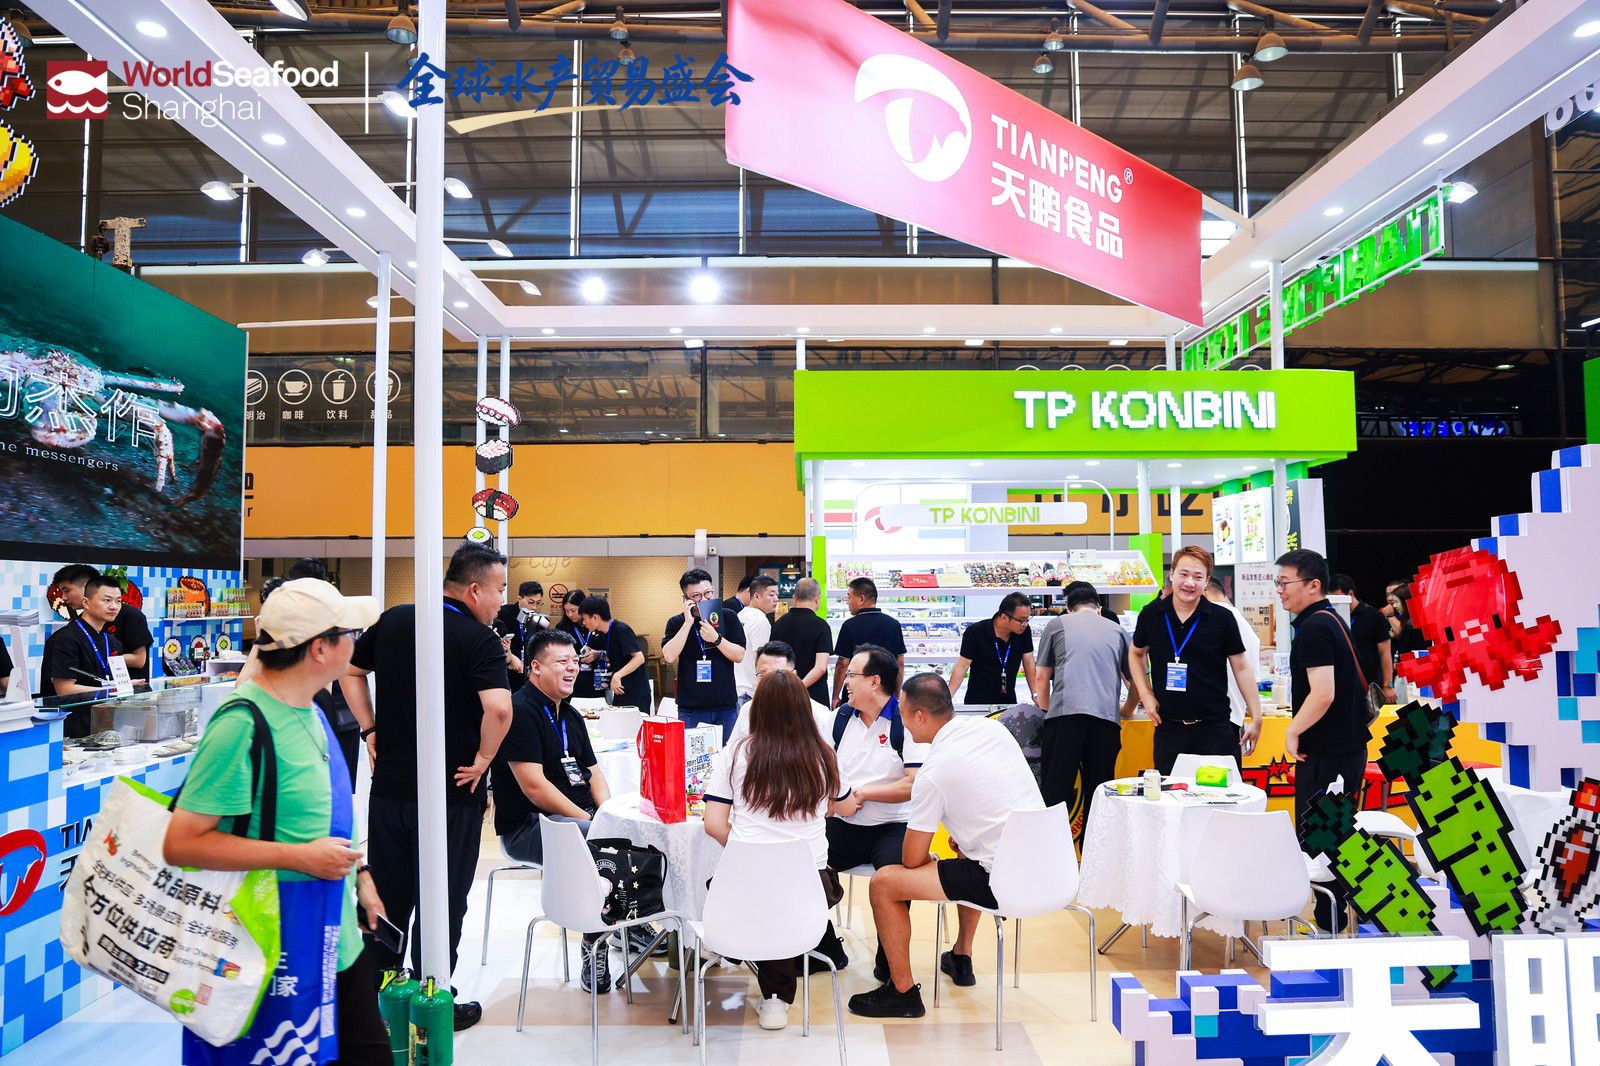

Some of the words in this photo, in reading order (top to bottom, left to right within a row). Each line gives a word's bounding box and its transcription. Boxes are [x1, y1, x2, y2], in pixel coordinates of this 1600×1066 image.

[991, 162, 1123, 259] 天鹏食品
[282, 410, 304, 420] 咖啡
[326, 409, 348, 420] 饮料
[1013, 390, 1077, 429] TP
[1091, 390, 1277, 429] KONBINI
[26, 446, 119, 471] messengers
[929, 507, 955, 524] TP
[961, 506, 1041, 524] KONBINI
[152, 867, 223, 915] 饮品原料
